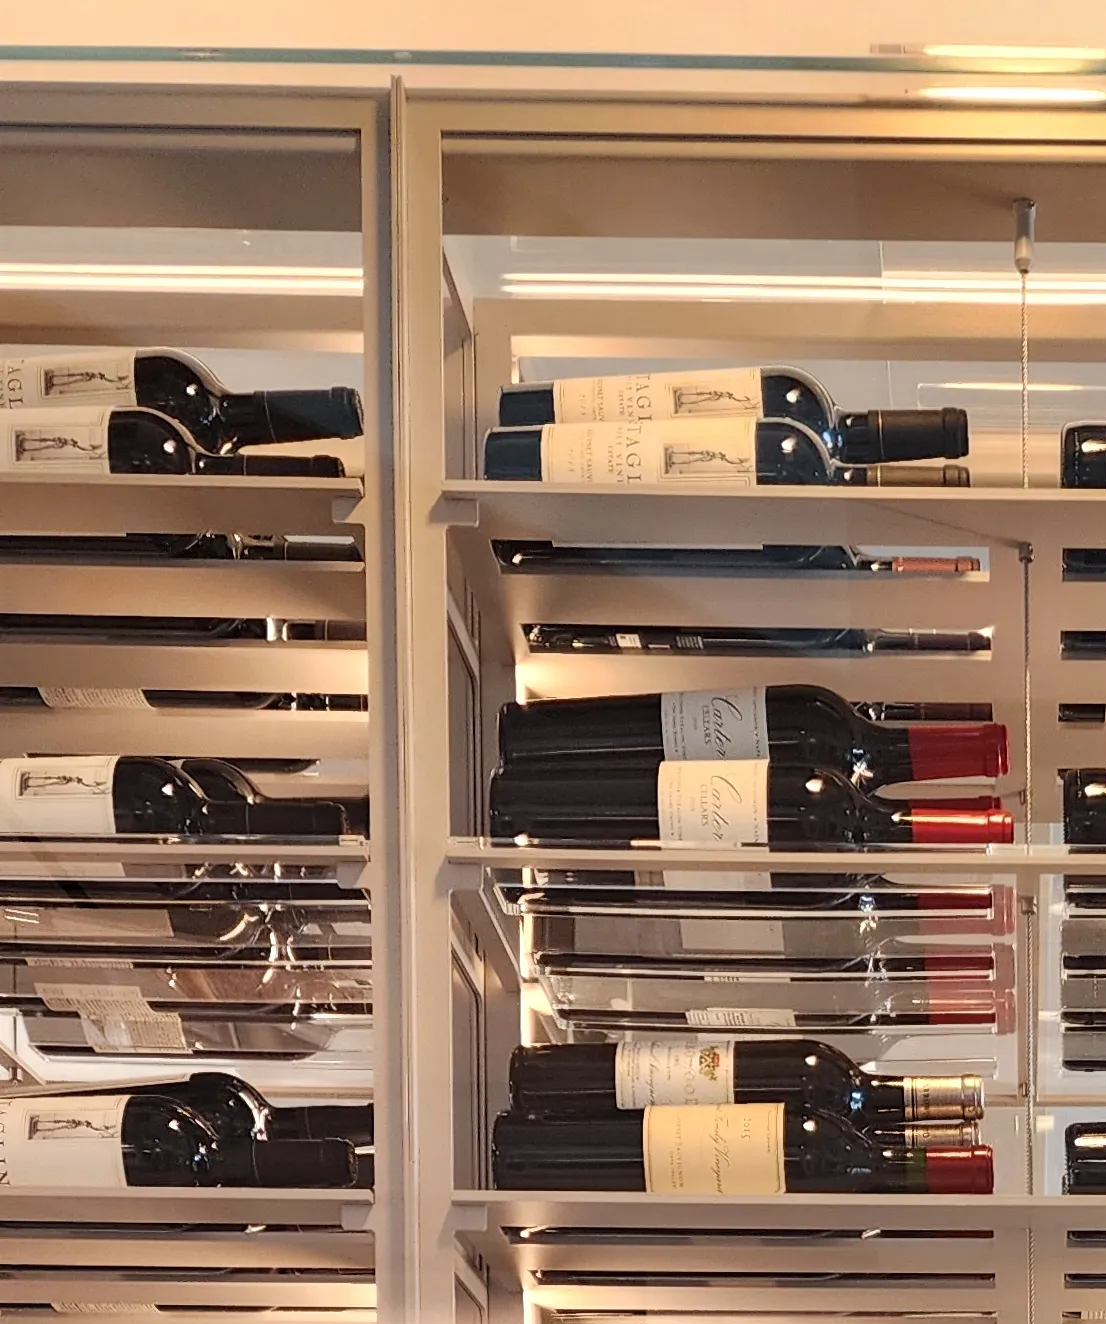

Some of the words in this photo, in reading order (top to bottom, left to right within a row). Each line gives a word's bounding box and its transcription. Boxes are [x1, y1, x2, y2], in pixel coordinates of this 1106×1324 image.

[626, 427, 643, 484] TAGL
[711, 696, 743, 759] Carter
[700, 784, 709, 826] CELLARS
[710, 774, 742, 841] Carter
